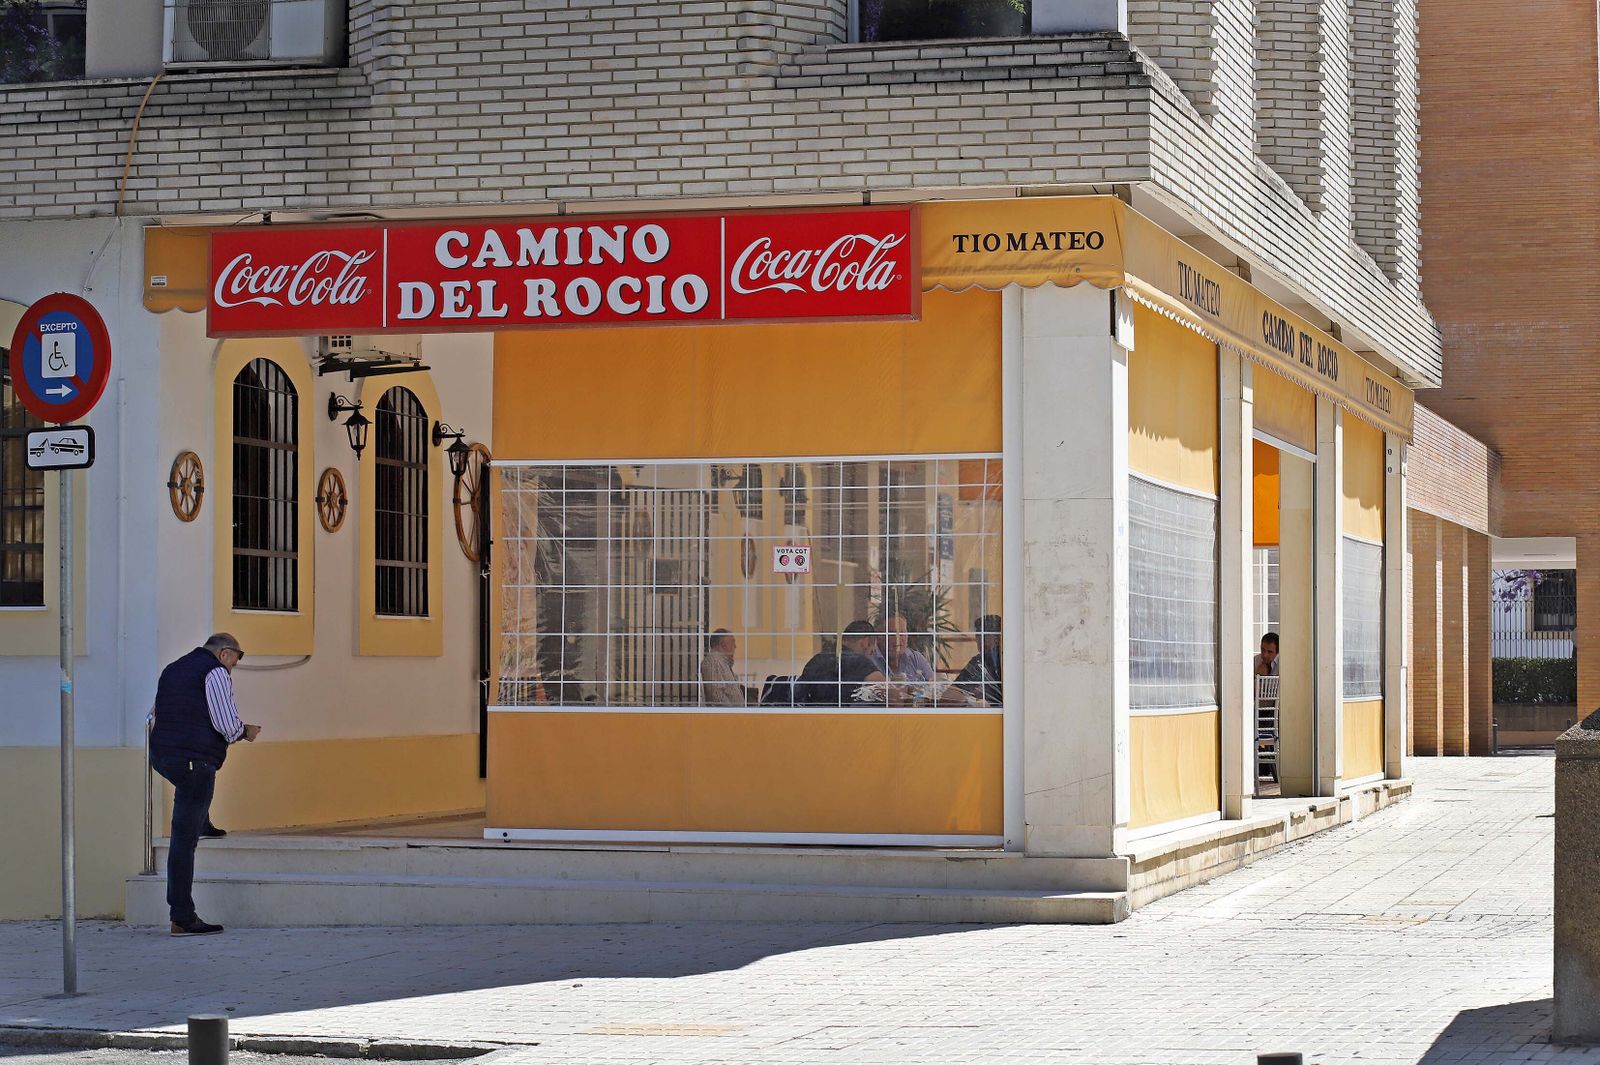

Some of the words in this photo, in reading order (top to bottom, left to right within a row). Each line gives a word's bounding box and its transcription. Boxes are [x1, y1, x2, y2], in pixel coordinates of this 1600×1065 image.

[434, 224, 670, 269] CAMINO
[731, 233, 907, 294] Coca-Cola
[952, 233, 1001, 253] TIO
[1003, 230, 1104, 251] MATEO
[214, 250, 376, 307] Coca-Cola
[397, 280, 509, 320] DEL
[523, 273, 709, 318] ROCIO
[1193, 270, 1221, 317] MATEO
[40, 322, 77, 332] EXCEPTO
[1299, 331, 1313, 369] DEL
[1317, 341, 1339, 382] ROCIO
